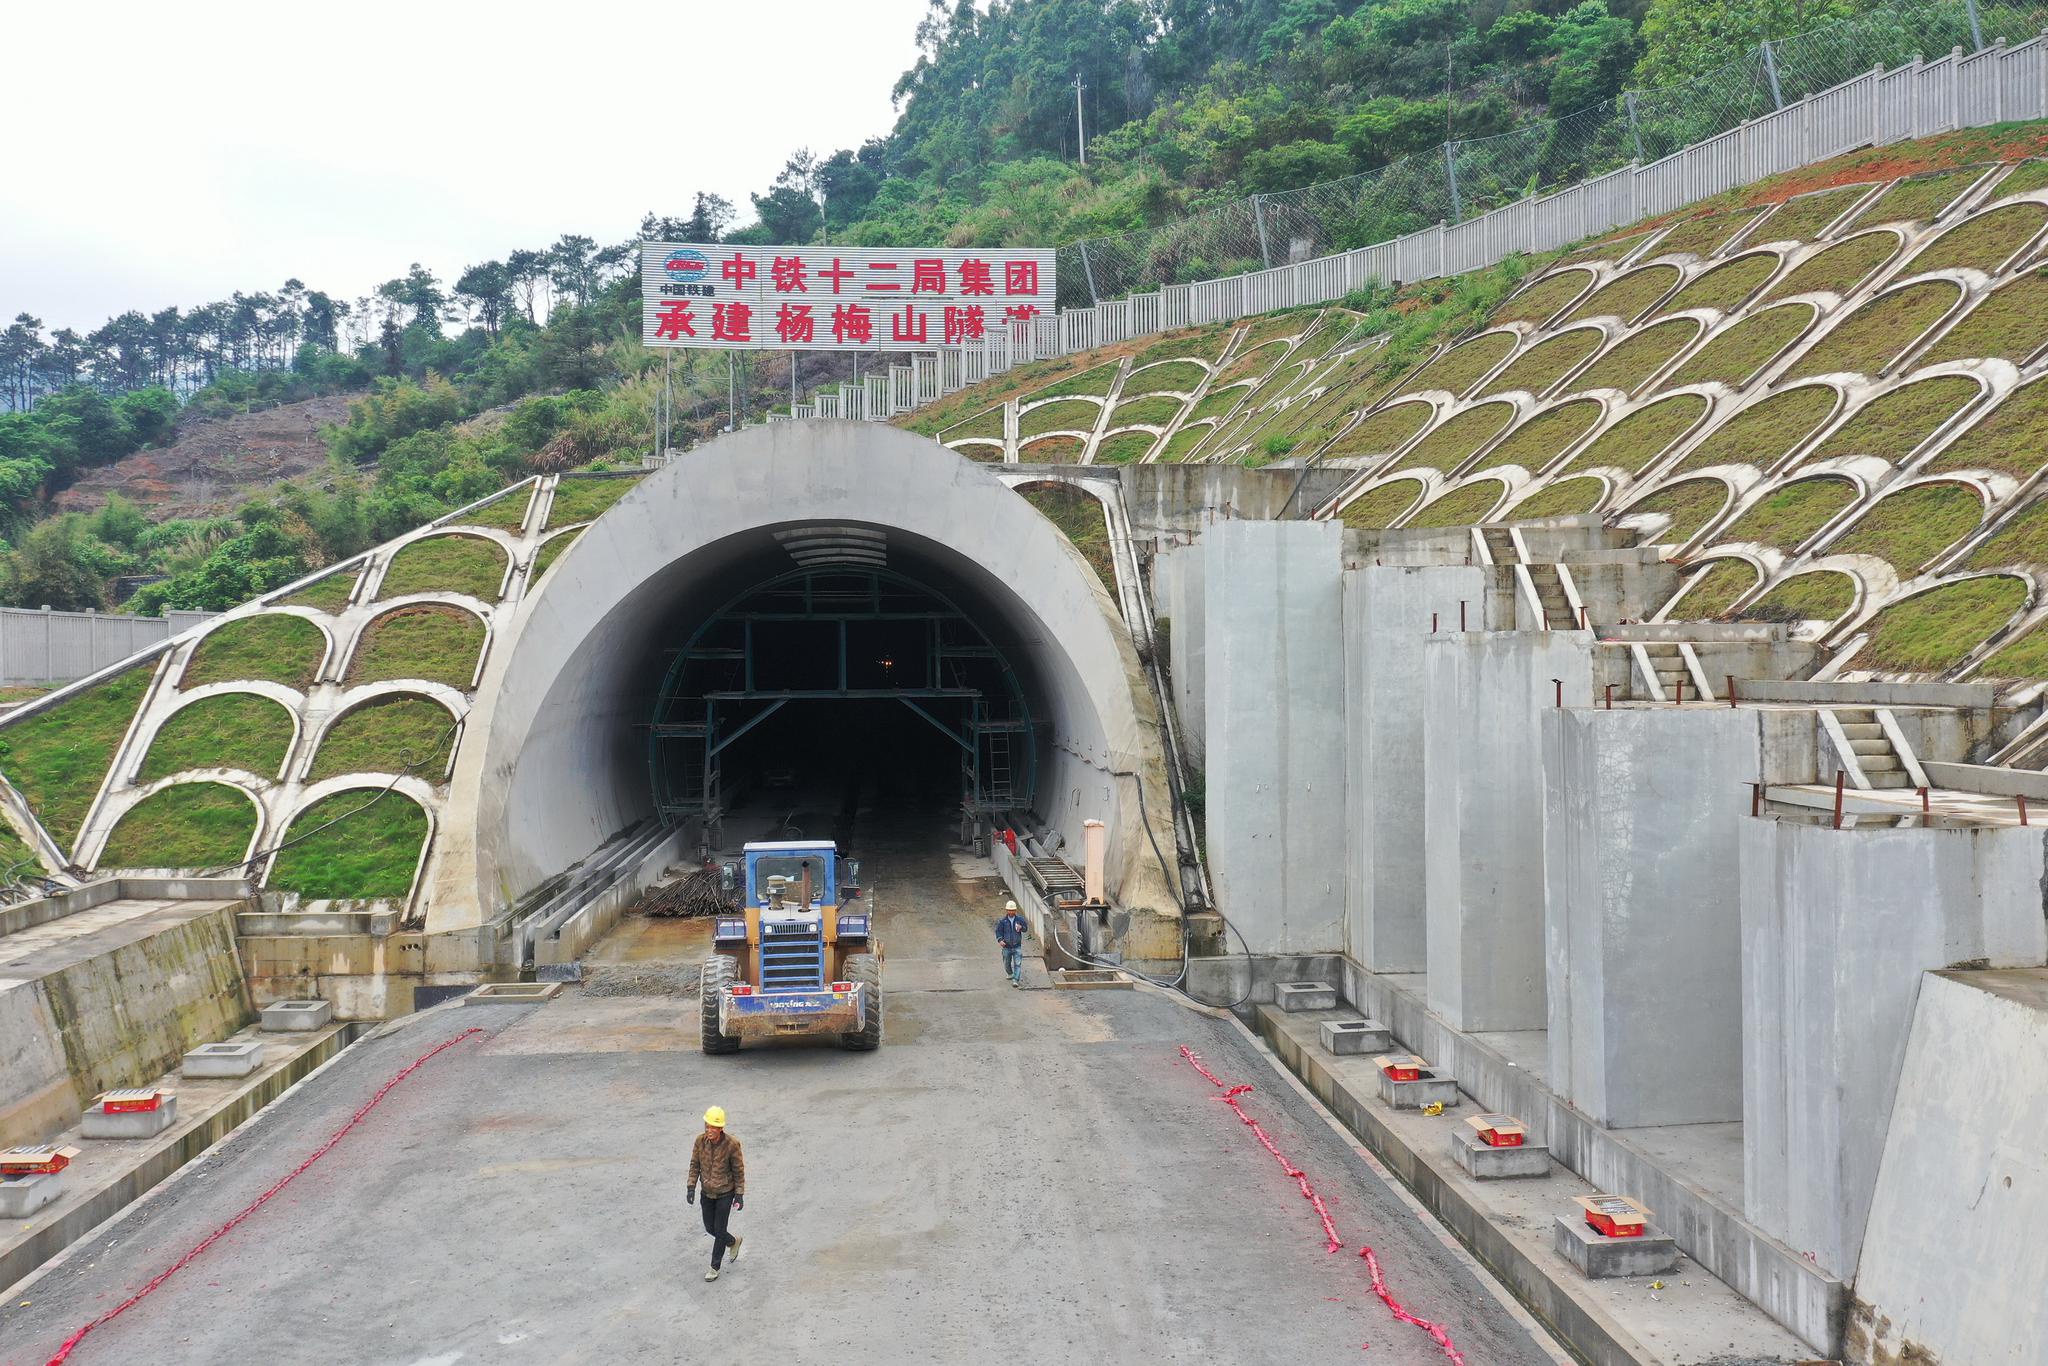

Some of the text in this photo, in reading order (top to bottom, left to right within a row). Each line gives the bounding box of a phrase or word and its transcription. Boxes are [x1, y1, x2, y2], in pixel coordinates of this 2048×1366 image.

[722, 253, 1039, 296] 中铁十二局集团
[660, 283, 715, 297] 中国铁建
